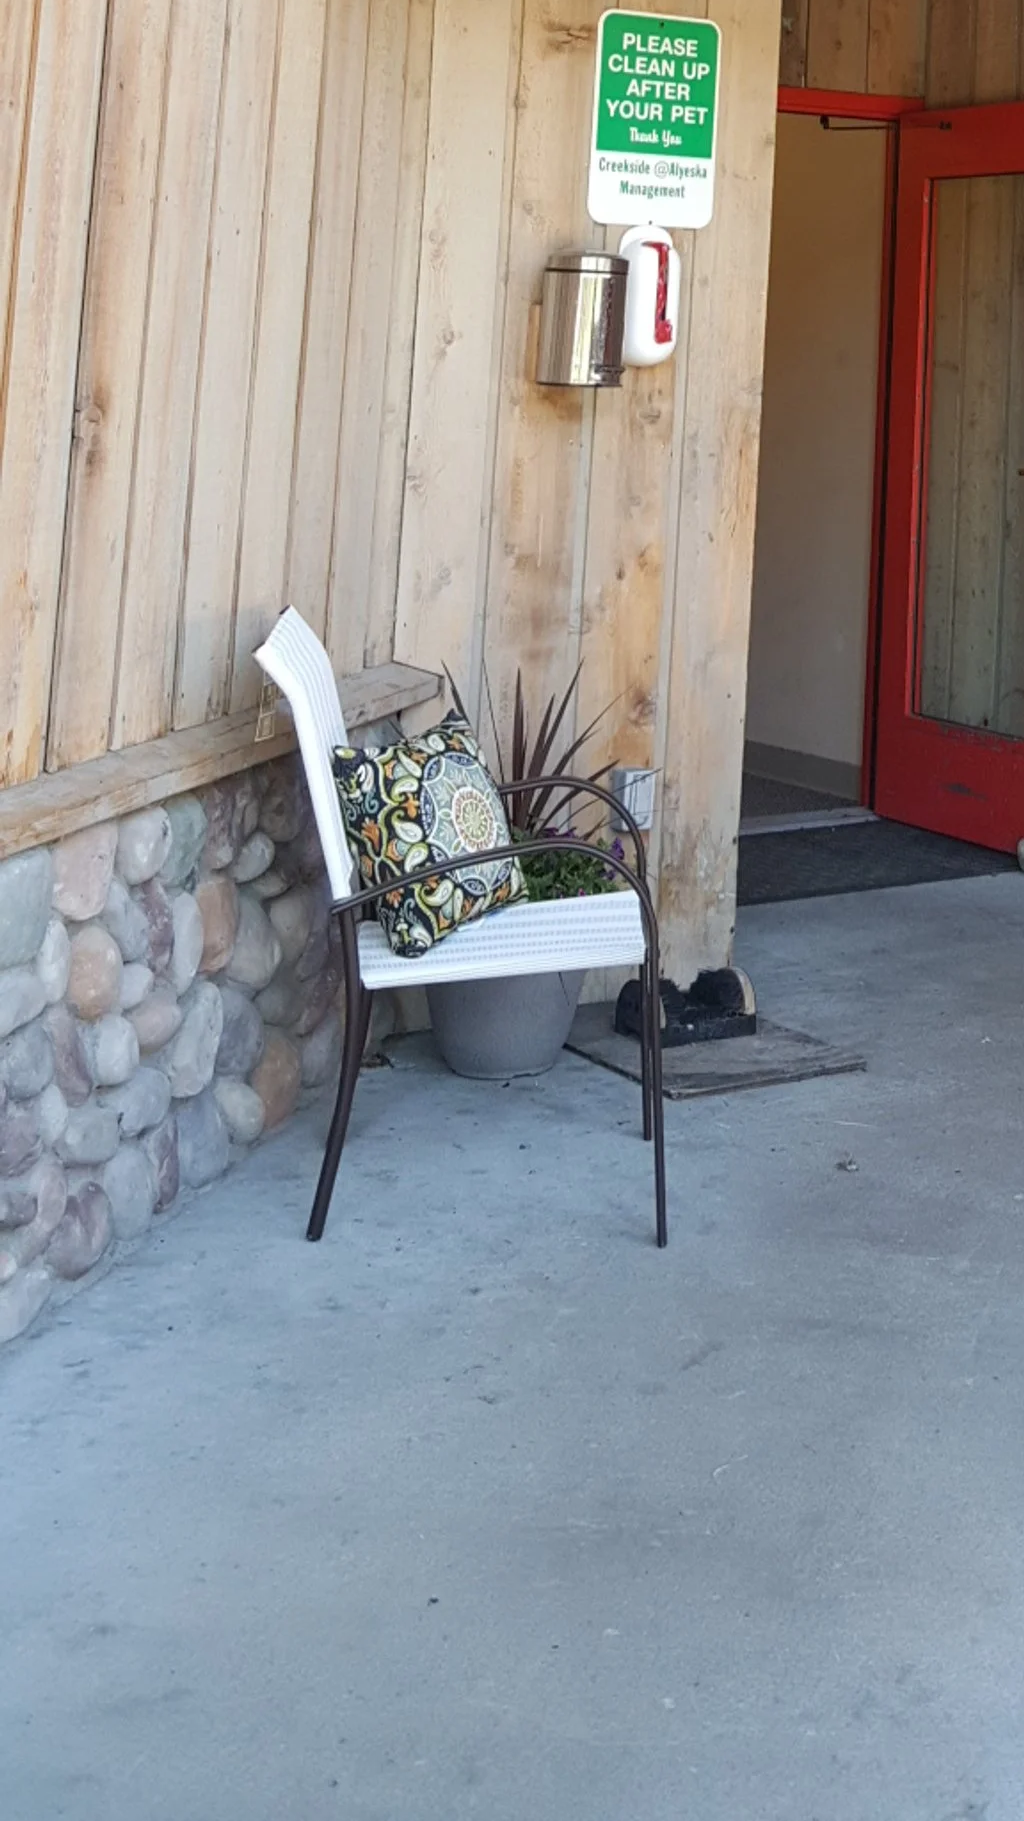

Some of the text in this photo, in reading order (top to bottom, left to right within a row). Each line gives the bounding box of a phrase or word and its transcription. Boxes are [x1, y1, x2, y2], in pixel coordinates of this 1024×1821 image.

[622, 32, 698, 57] PLEASE
[608, 53, 710, 80] CLEAN UP
[626, 78, 690, 101] AFTER
[606, 98, 708, 125] YOUR PET
[629, 126, 682, 147] Thank You
[599, 157, 650, 174] Creekside
[619, 180, 685, 199] Management
